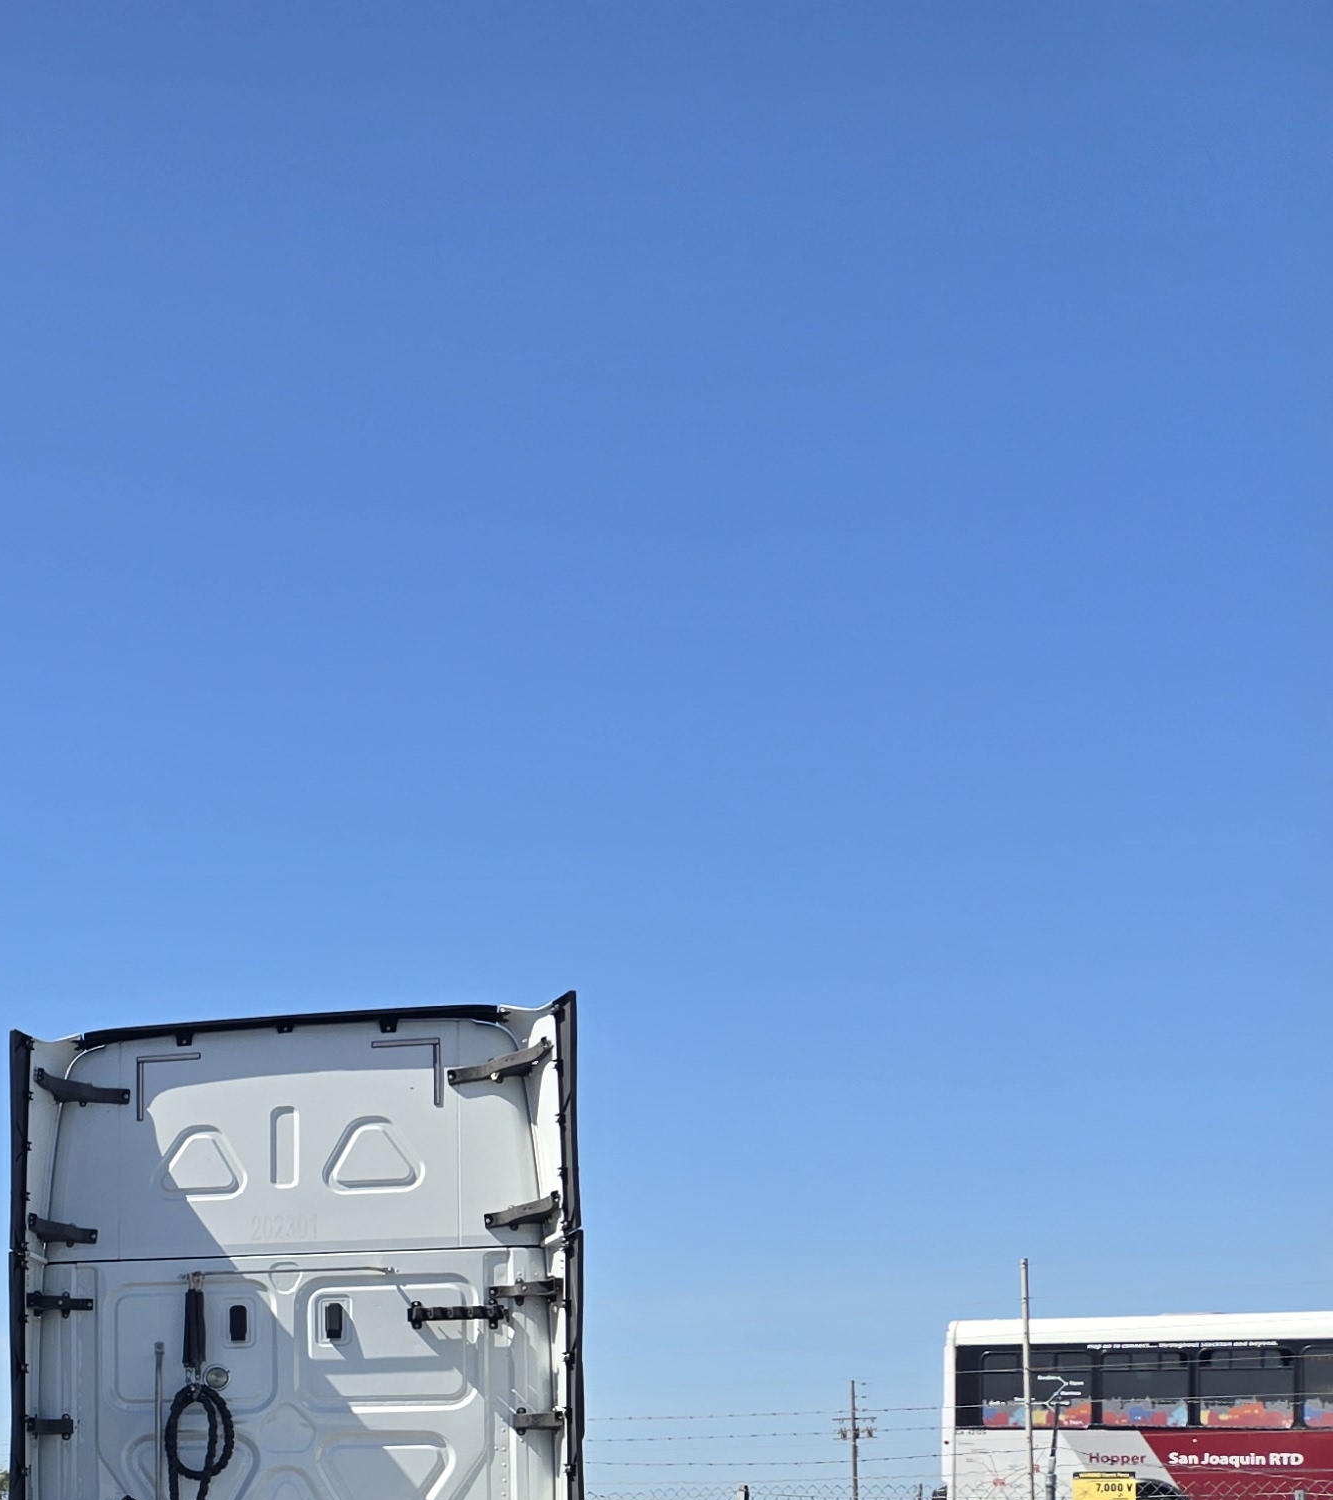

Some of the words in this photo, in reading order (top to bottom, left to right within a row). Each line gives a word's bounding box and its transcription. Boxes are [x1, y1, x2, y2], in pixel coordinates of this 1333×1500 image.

[1089, 1453, 1147, 1467] Hopper
[1168, 1452, 1198, 1465] San
[1199, 1452, 1266, 1468] Joaquin
[1268, 1452, 1304, 1466] RTD
